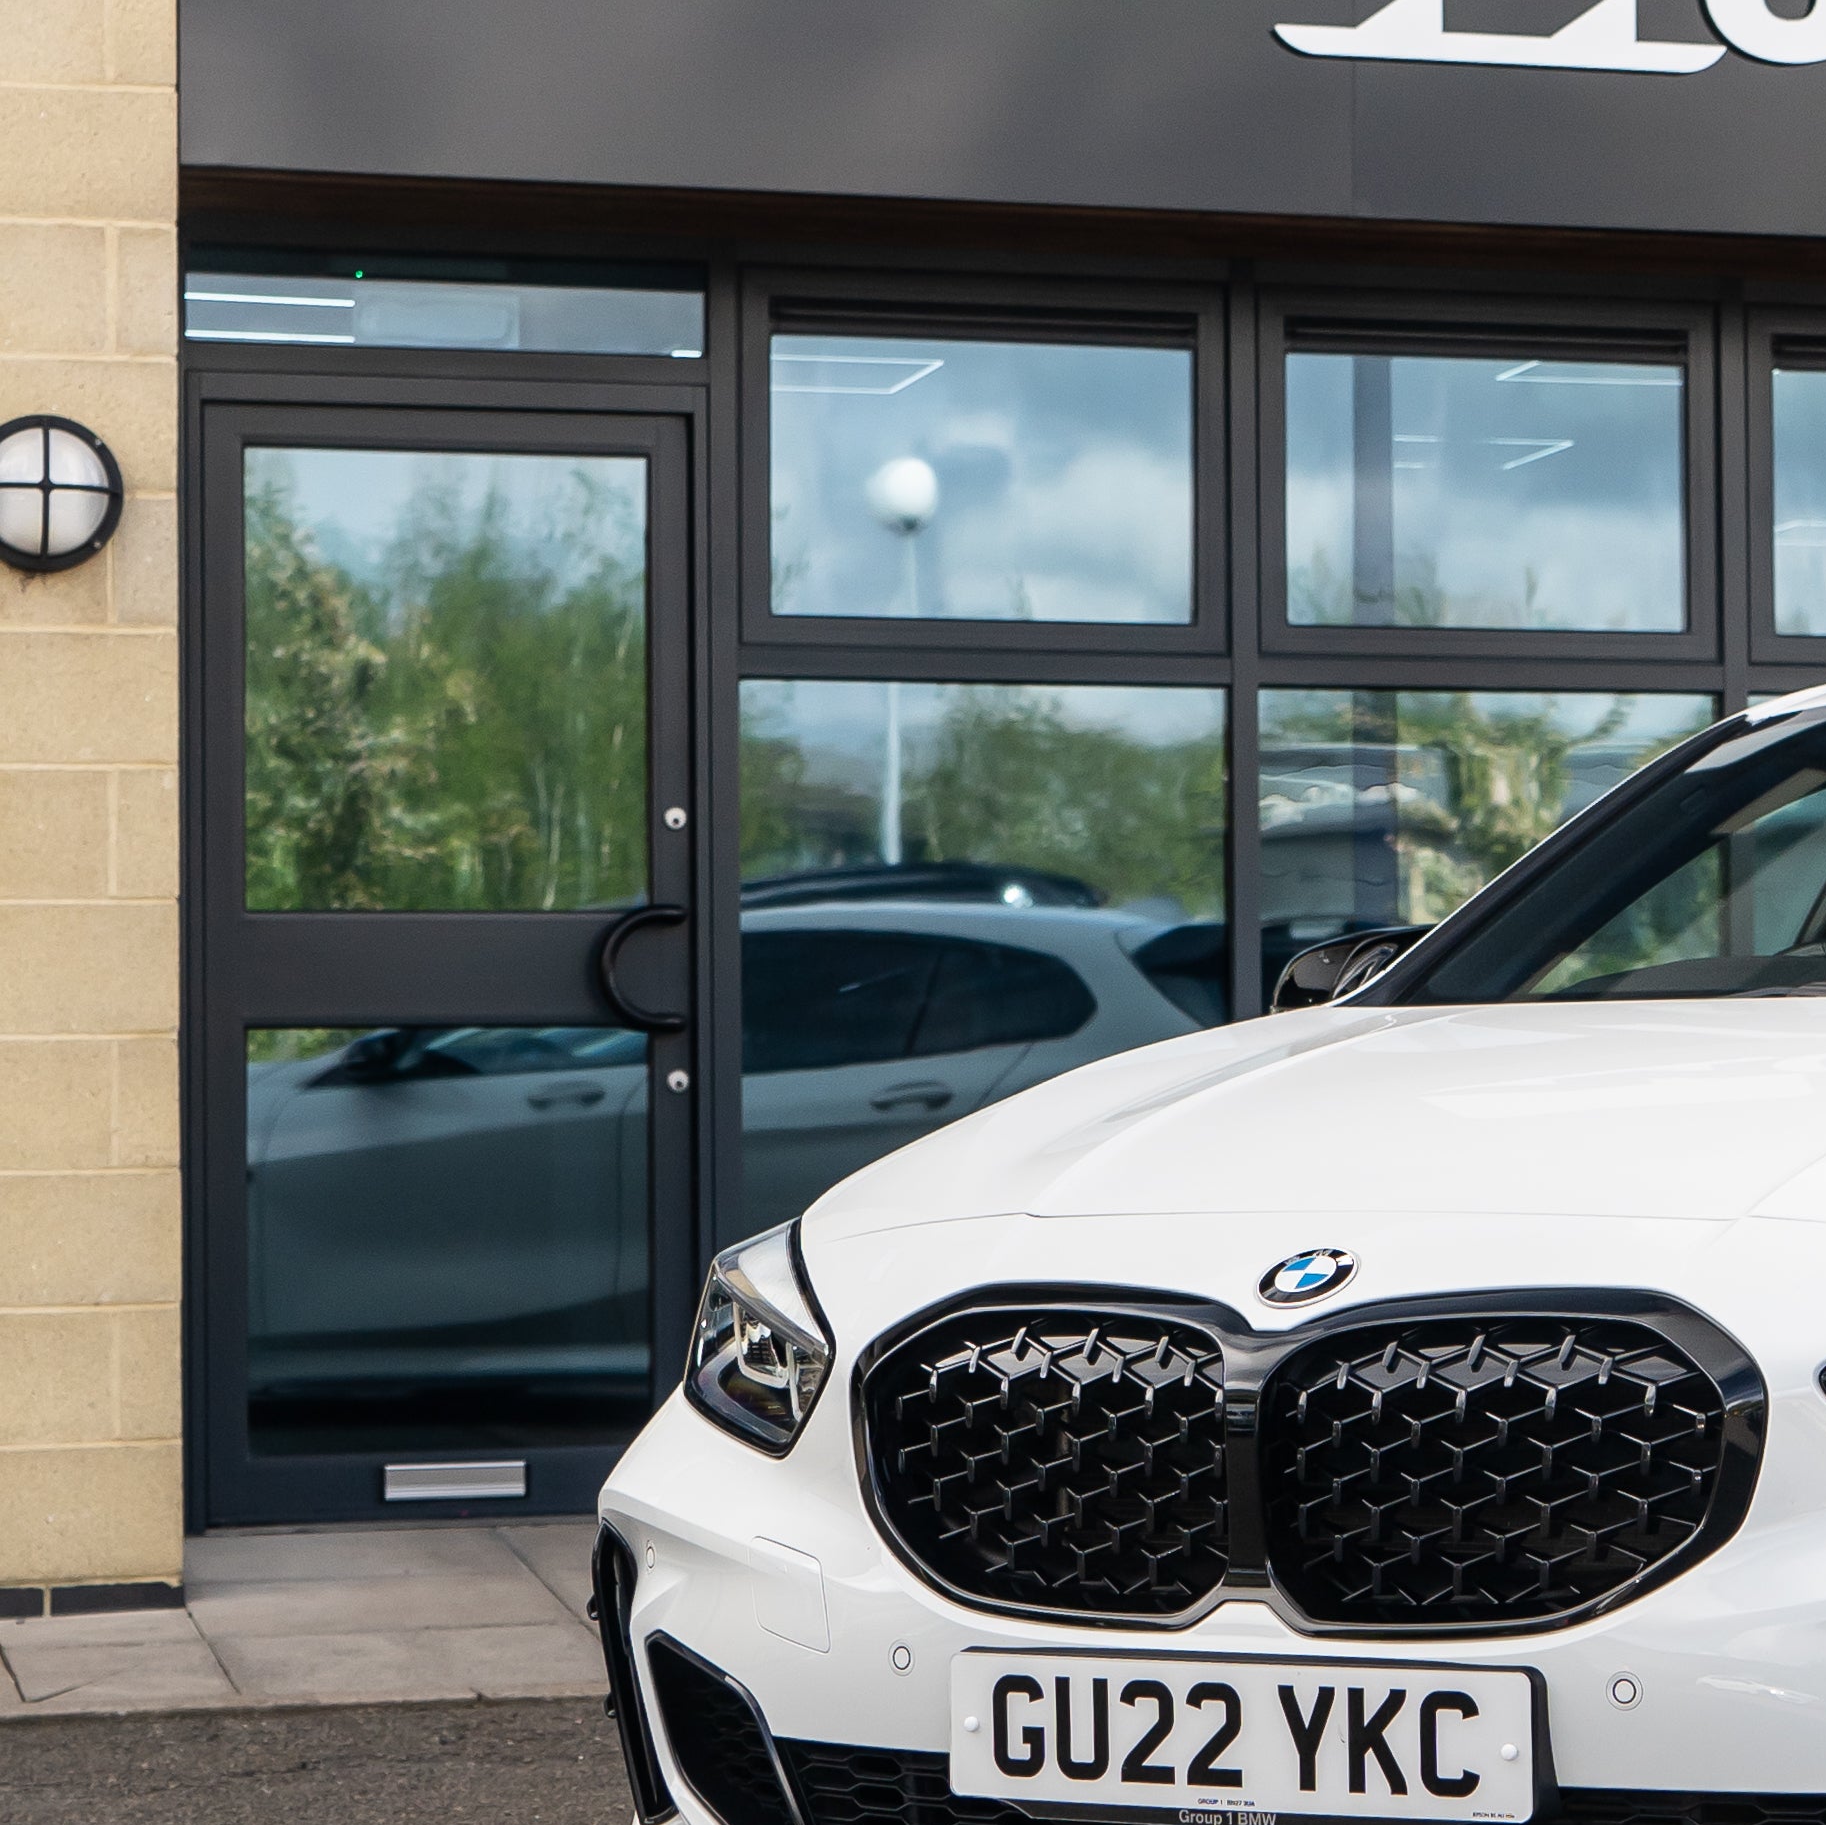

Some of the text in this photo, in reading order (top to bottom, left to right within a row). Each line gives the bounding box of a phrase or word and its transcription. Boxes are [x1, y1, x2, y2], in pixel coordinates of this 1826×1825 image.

[992, 1673, 1480, 1799] GU22 YKC
[1226, 1811, 1233, 1825] 1
